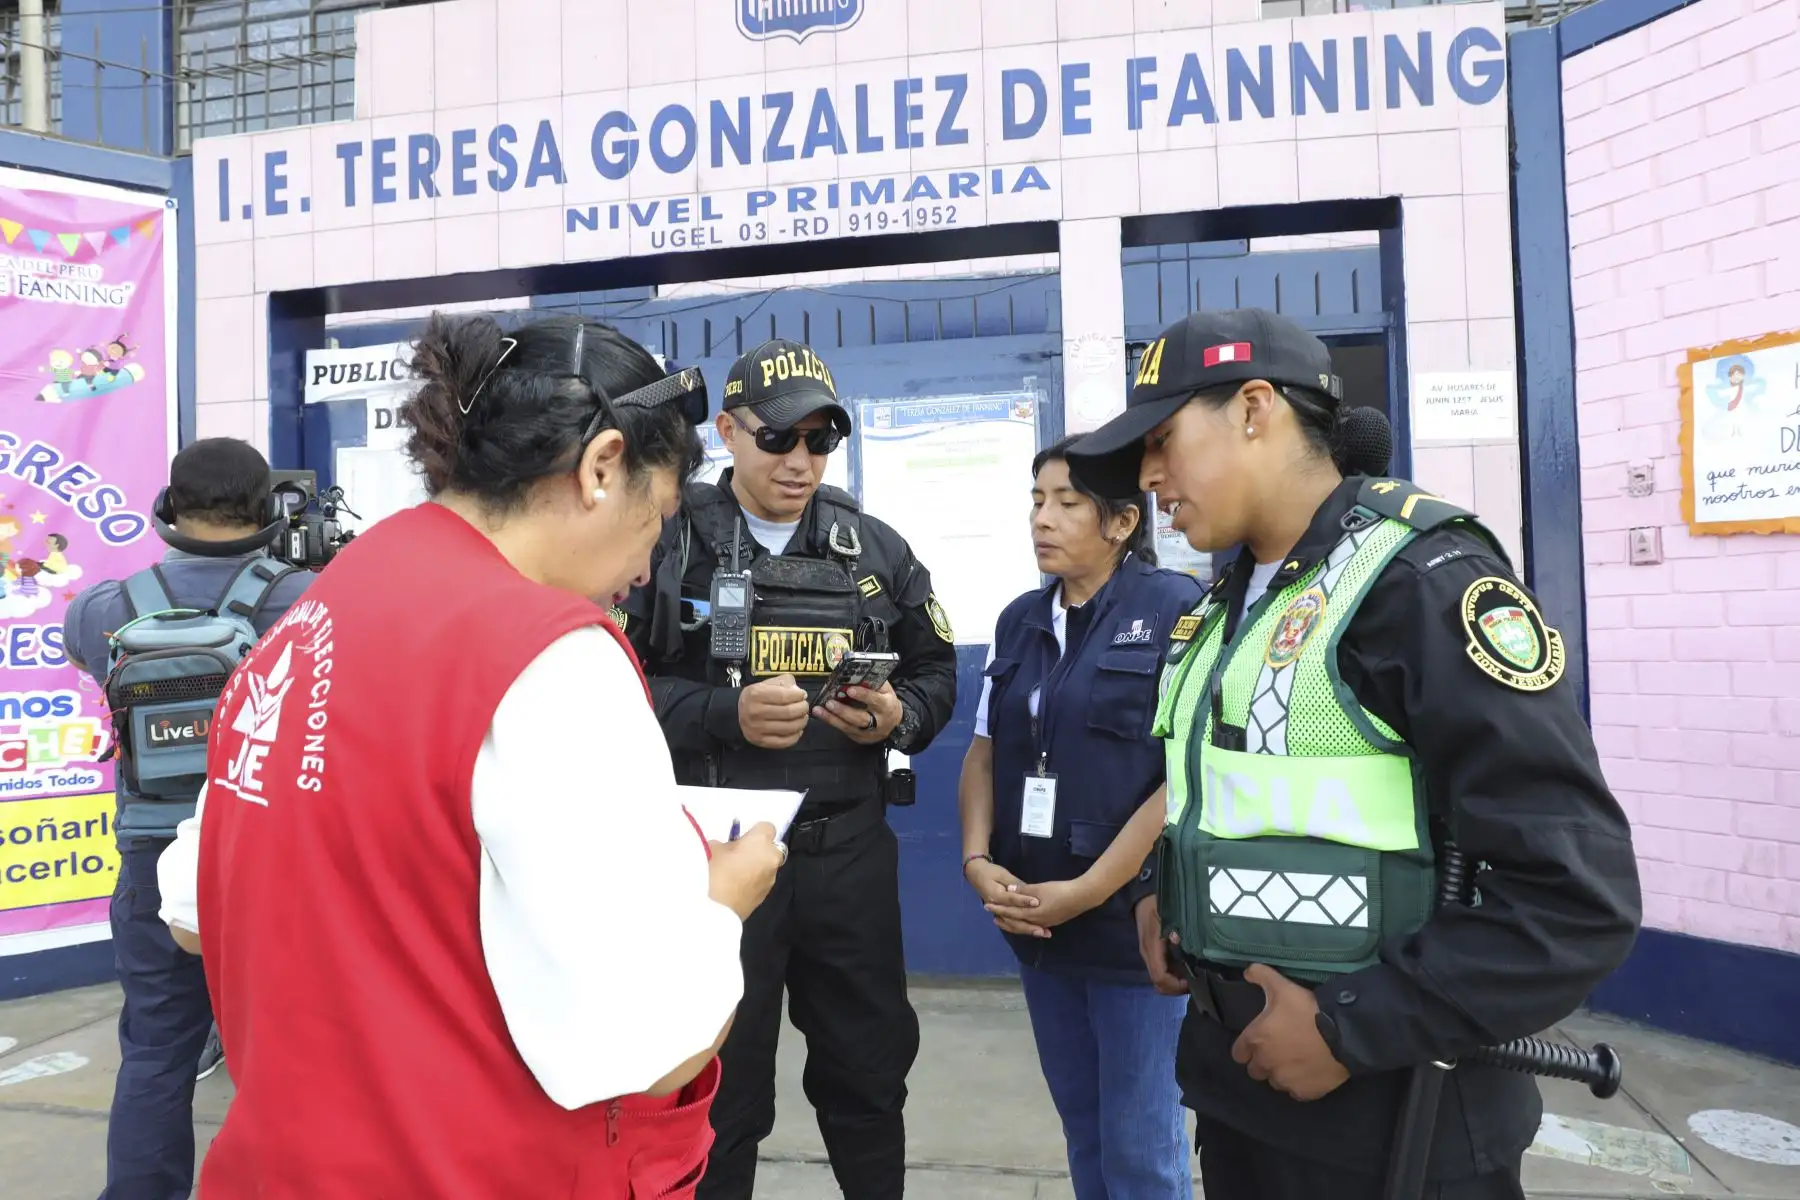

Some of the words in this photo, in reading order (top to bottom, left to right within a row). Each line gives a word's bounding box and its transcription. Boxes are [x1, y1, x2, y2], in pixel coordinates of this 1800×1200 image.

[219, 151, 310, 221] I.E.
[336, 120, 567, 207] TERESA
[591, 73, 969, 180] GONZALEZ
[1002, 63, 1092, 140] DE
[1127, 27, 1505, 130] FANNING
[567, 196, 723, 232] NIVEL
[747, 166, 1051, 216] PRIMARIA
[652, 227, 723, 248] UGEL
[739, 222, 767, 241] 03
[849, 205, 957, 232] 919-1952
[23, 260, 53, 273] DEL
[312, 358, 413, 386] PUBLIC
[1703, 482, 1779, 506] nosotros
[1707, 468, 1735, 493] que
[0, 626, 68, 666] ES
[757, 632, 825, 672] POLICIA
[1114, 628, 1152, 644] ONPE
[1511, 672, 1550, 687] JESUS
[1547, 637, 1561, 676] MARIA
[150, 719, 209, 741] LiveU
[49, 774, 96, 787] Todos
[0, 811, 108, 846] oñarl
[0, 851, 114, 884] cerlo.
